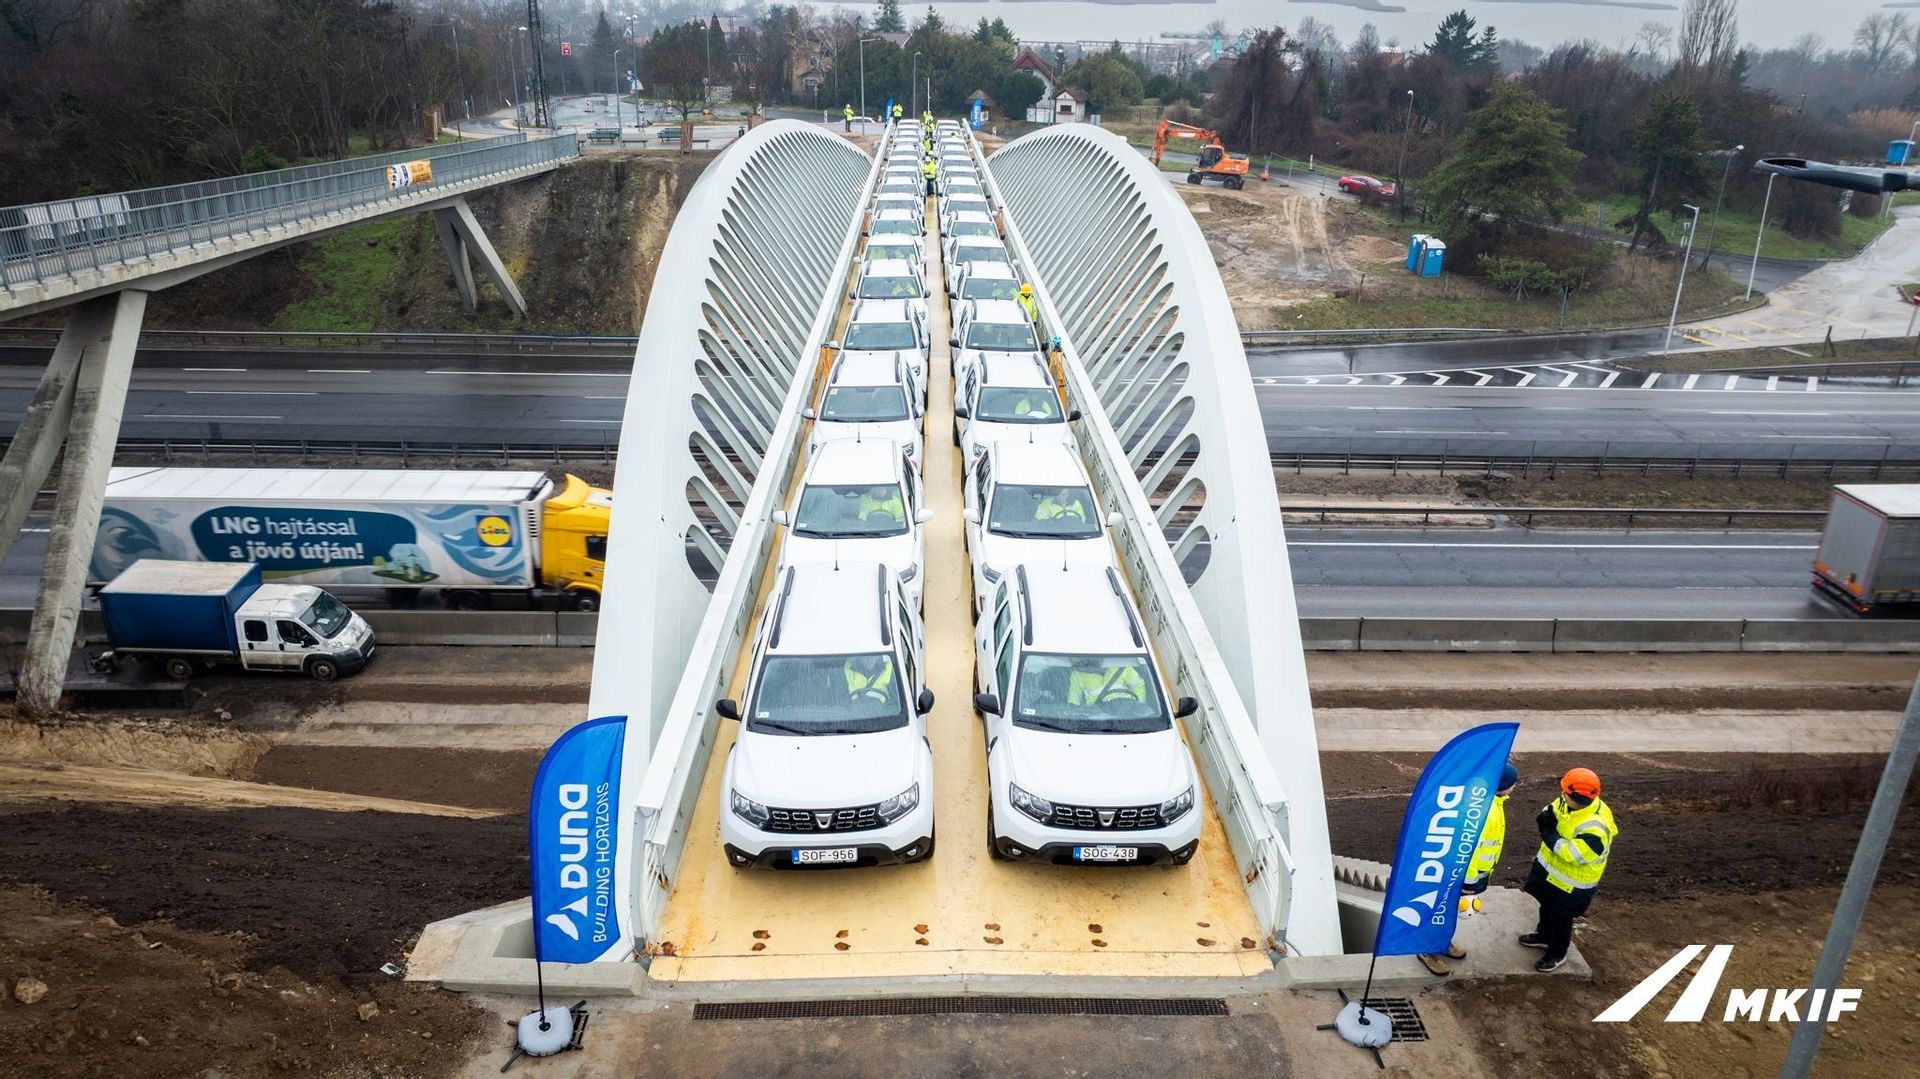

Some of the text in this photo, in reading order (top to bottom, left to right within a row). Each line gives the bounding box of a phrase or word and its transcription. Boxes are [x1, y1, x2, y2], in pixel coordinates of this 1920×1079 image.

[211, 516, 357, 540] LNG hajtással
[229, 541, 365, 563] a jövő útján!
[1456, 785, 1487, 865] HORIZONS
[593, 782, 611, 943] BUILDING HORIZONS
[801, 849, 854, 861] SOF-956
[1083, 848, 1135, 858] SOG-438
